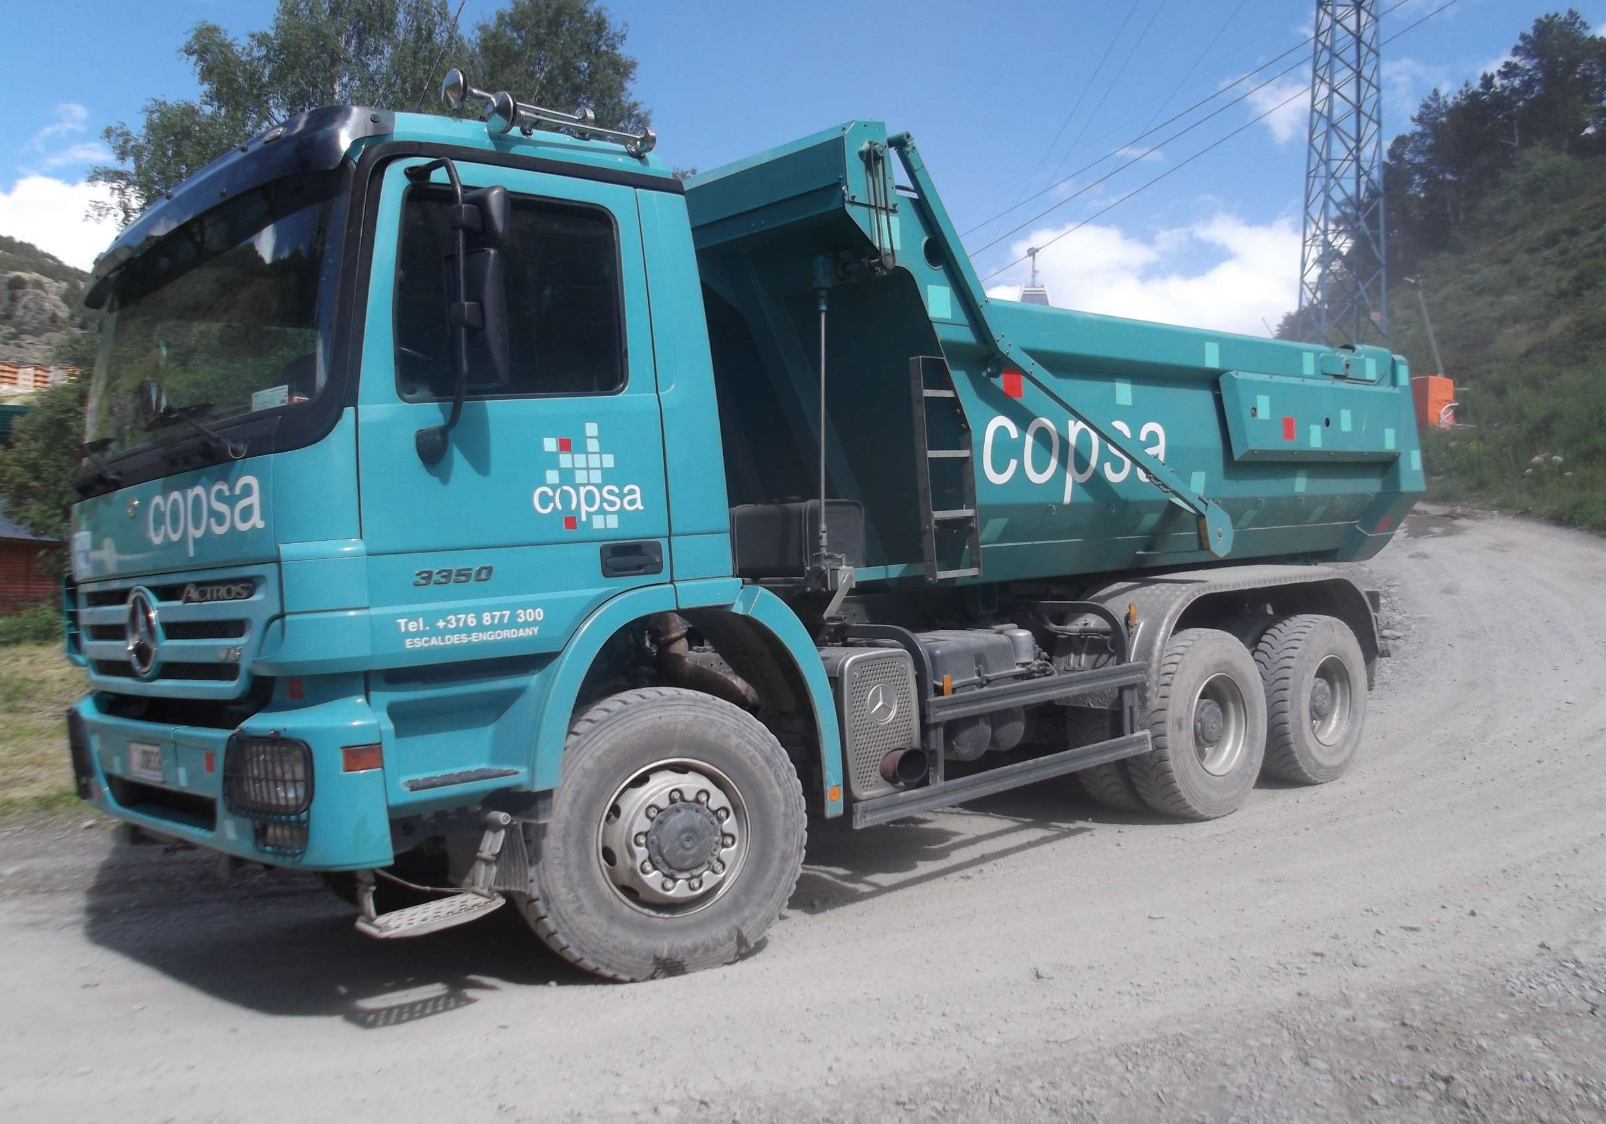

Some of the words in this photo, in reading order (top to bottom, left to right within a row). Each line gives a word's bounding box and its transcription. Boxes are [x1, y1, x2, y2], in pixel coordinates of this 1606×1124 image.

[982, 415, 1166, 505] copsa
[150, 475, 265, 558] copsa
[533, 484, 644, 521] copsa
[412, 565, 494, 587] 3350
[396, 617, 430, 633] Tel.
[436, 613, 477, 630] +376
[482, 610, 511, 626] 877
[516, 607, 544, 622] 300
[405, 626, 540, 649] ESCALDES-ENGORDANY
